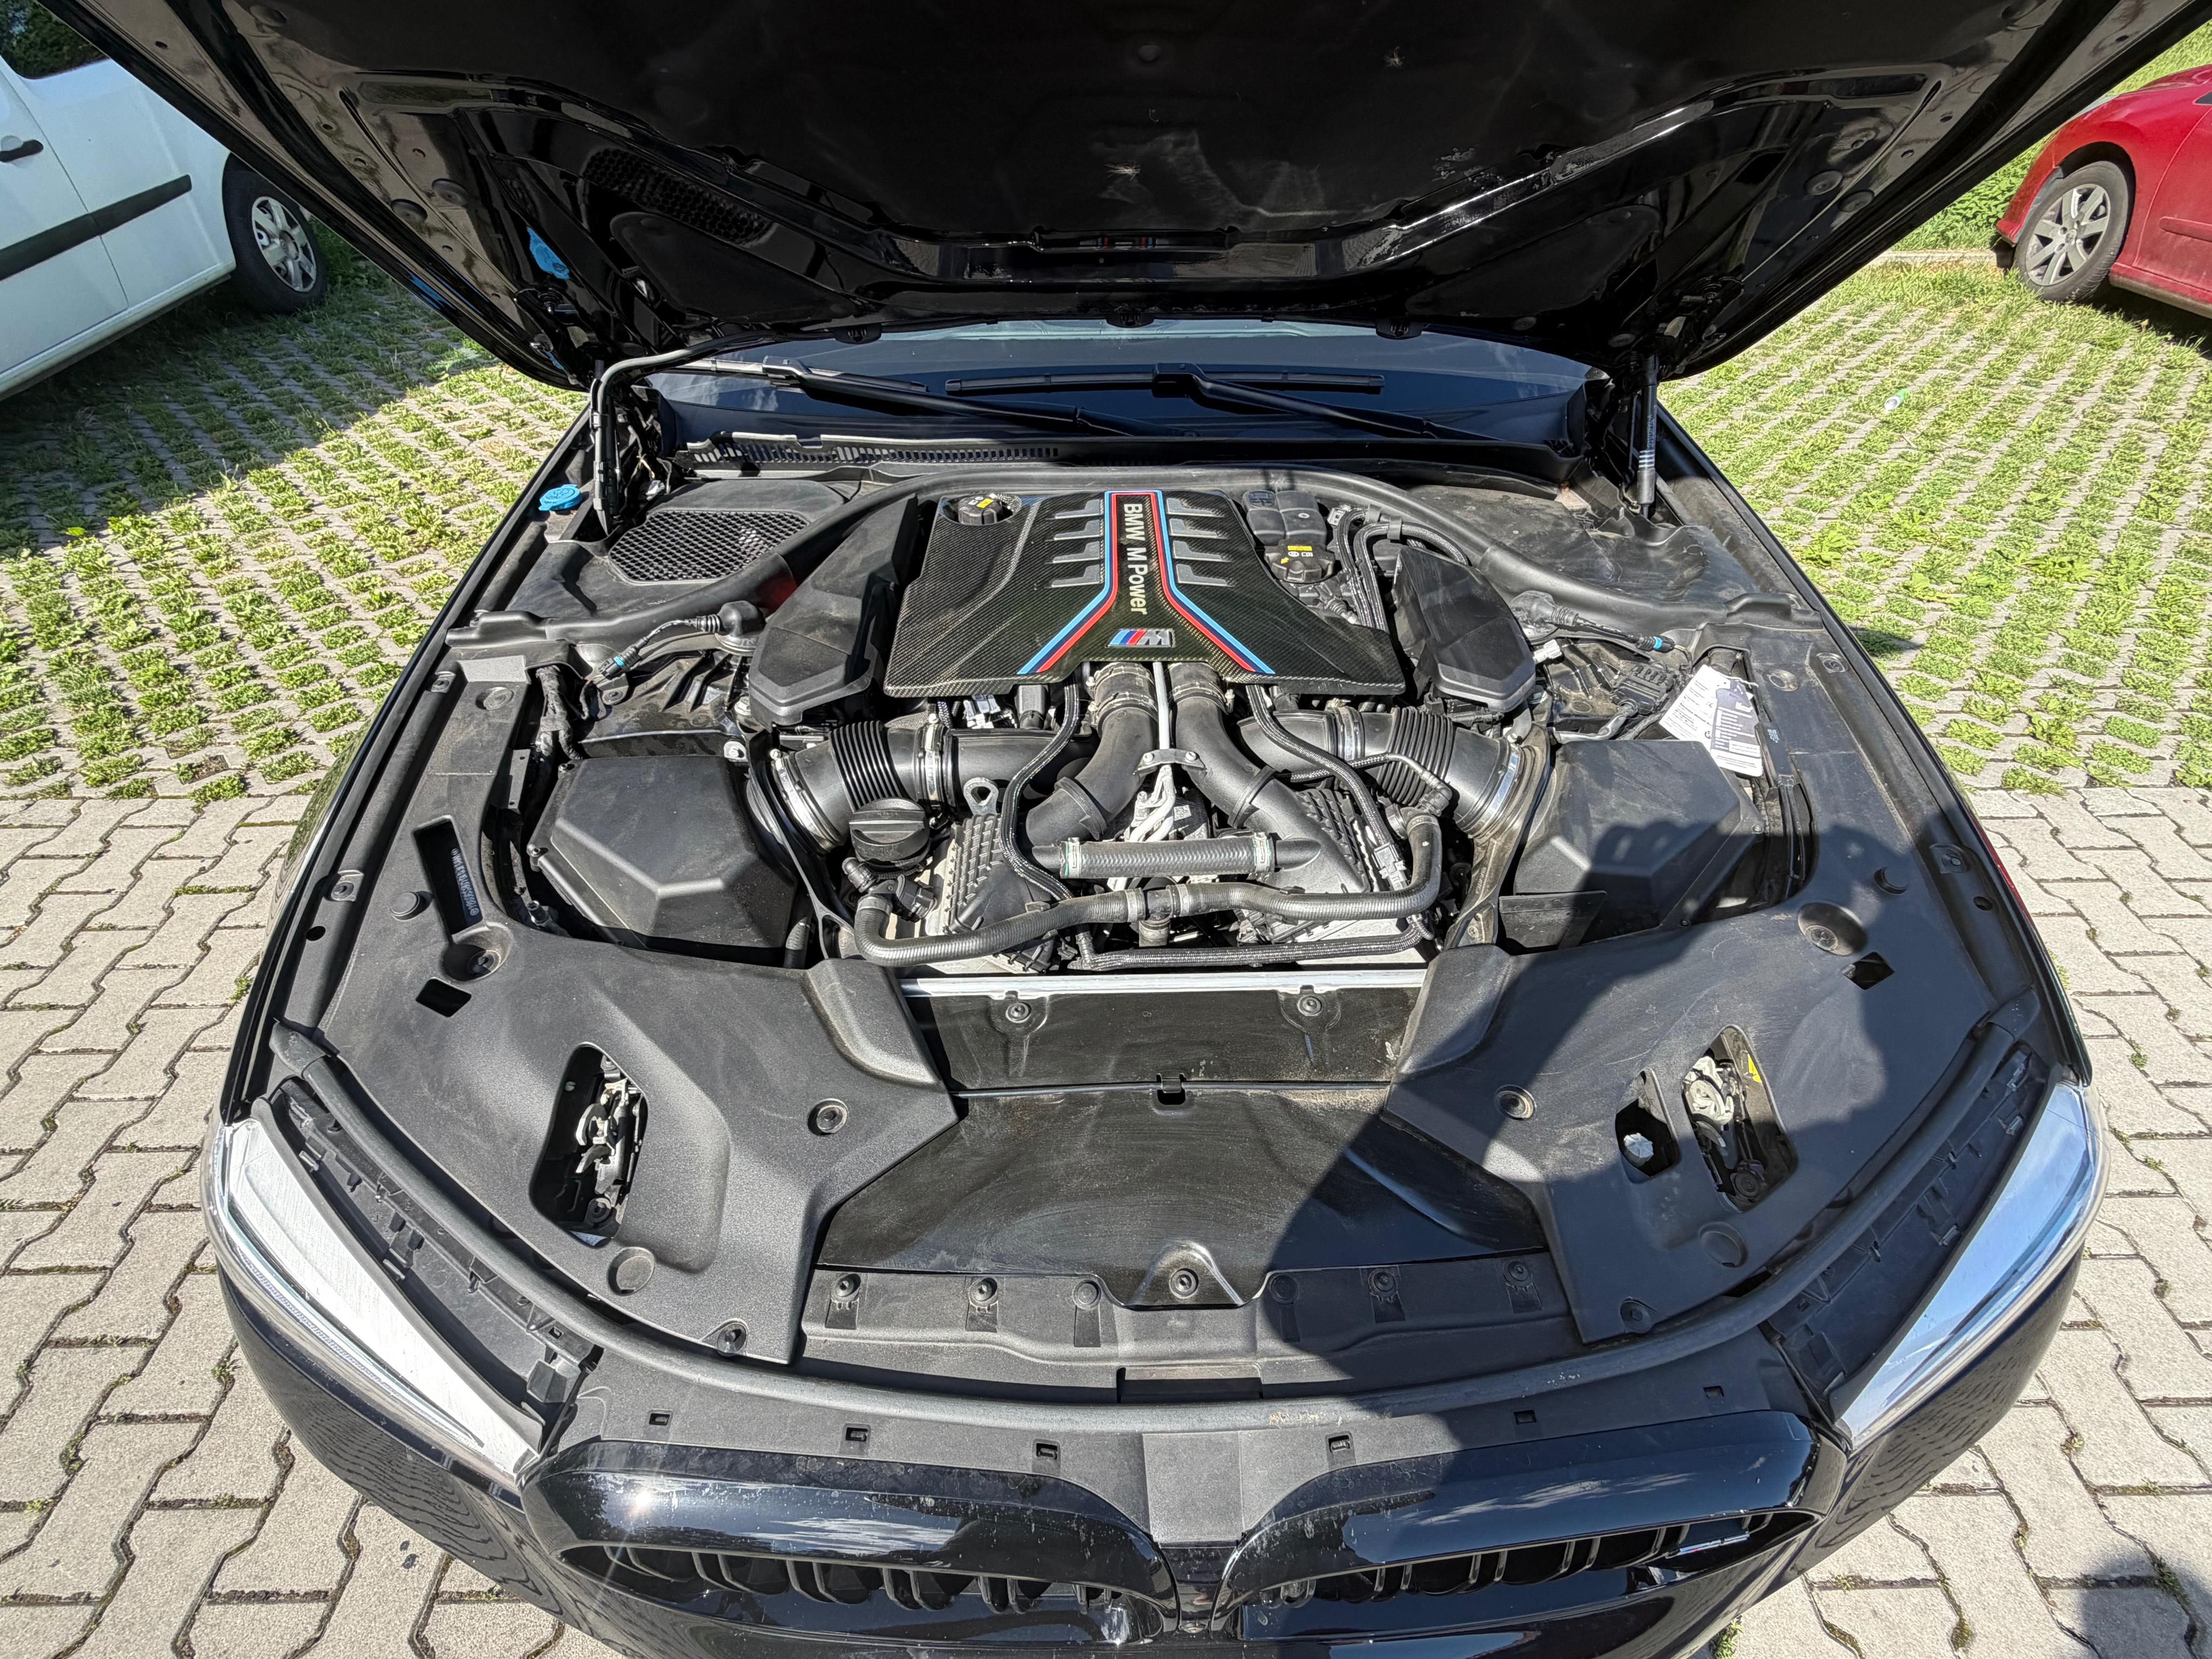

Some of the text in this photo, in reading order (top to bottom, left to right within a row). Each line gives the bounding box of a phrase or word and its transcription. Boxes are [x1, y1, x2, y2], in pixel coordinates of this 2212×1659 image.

[1123, 503, 1148, 615] BMW M Power
